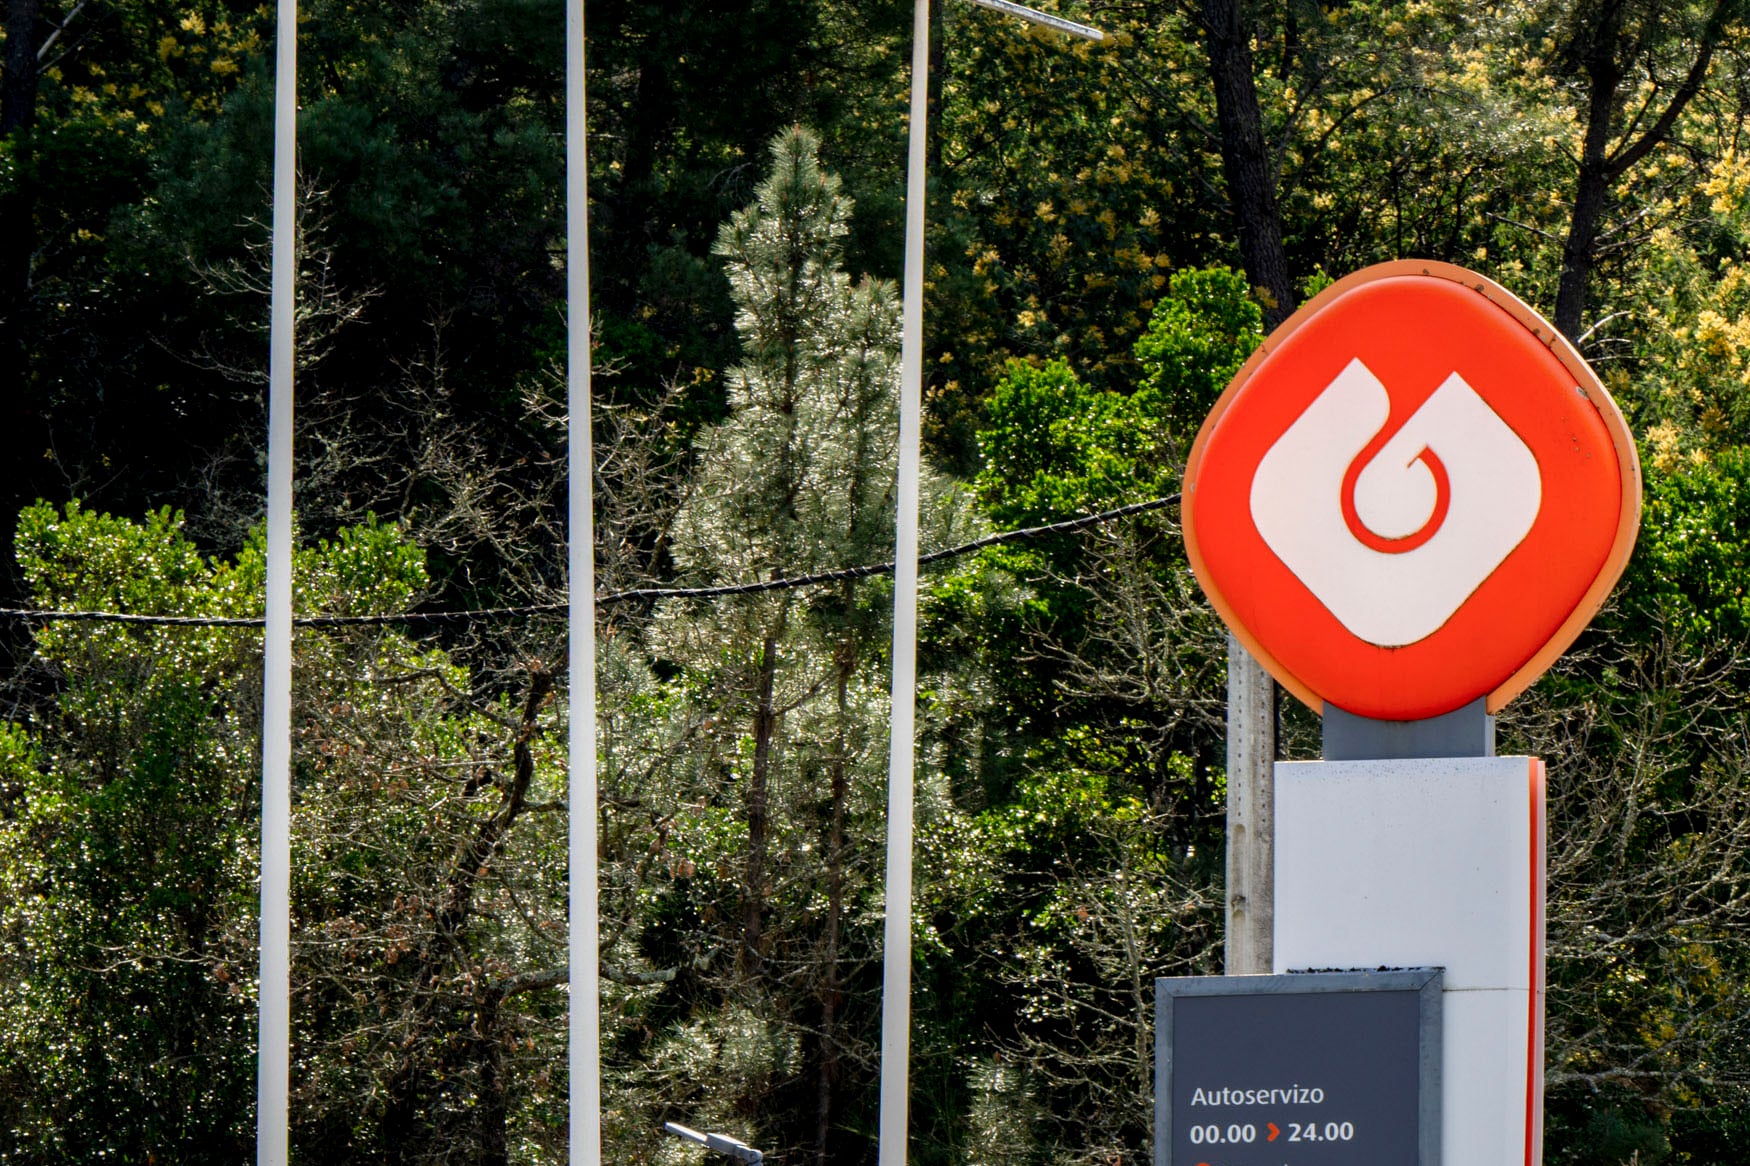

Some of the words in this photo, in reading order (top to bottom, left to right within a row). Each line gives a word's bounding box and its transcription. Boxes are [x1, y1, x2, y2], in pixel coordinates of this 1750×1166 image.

[1190, 1084, 1325, 1106] Autoservizo
[1190, 1124, 1257, 1144] 00.00
[1287, 1122, 1355, 1142] 24.00
